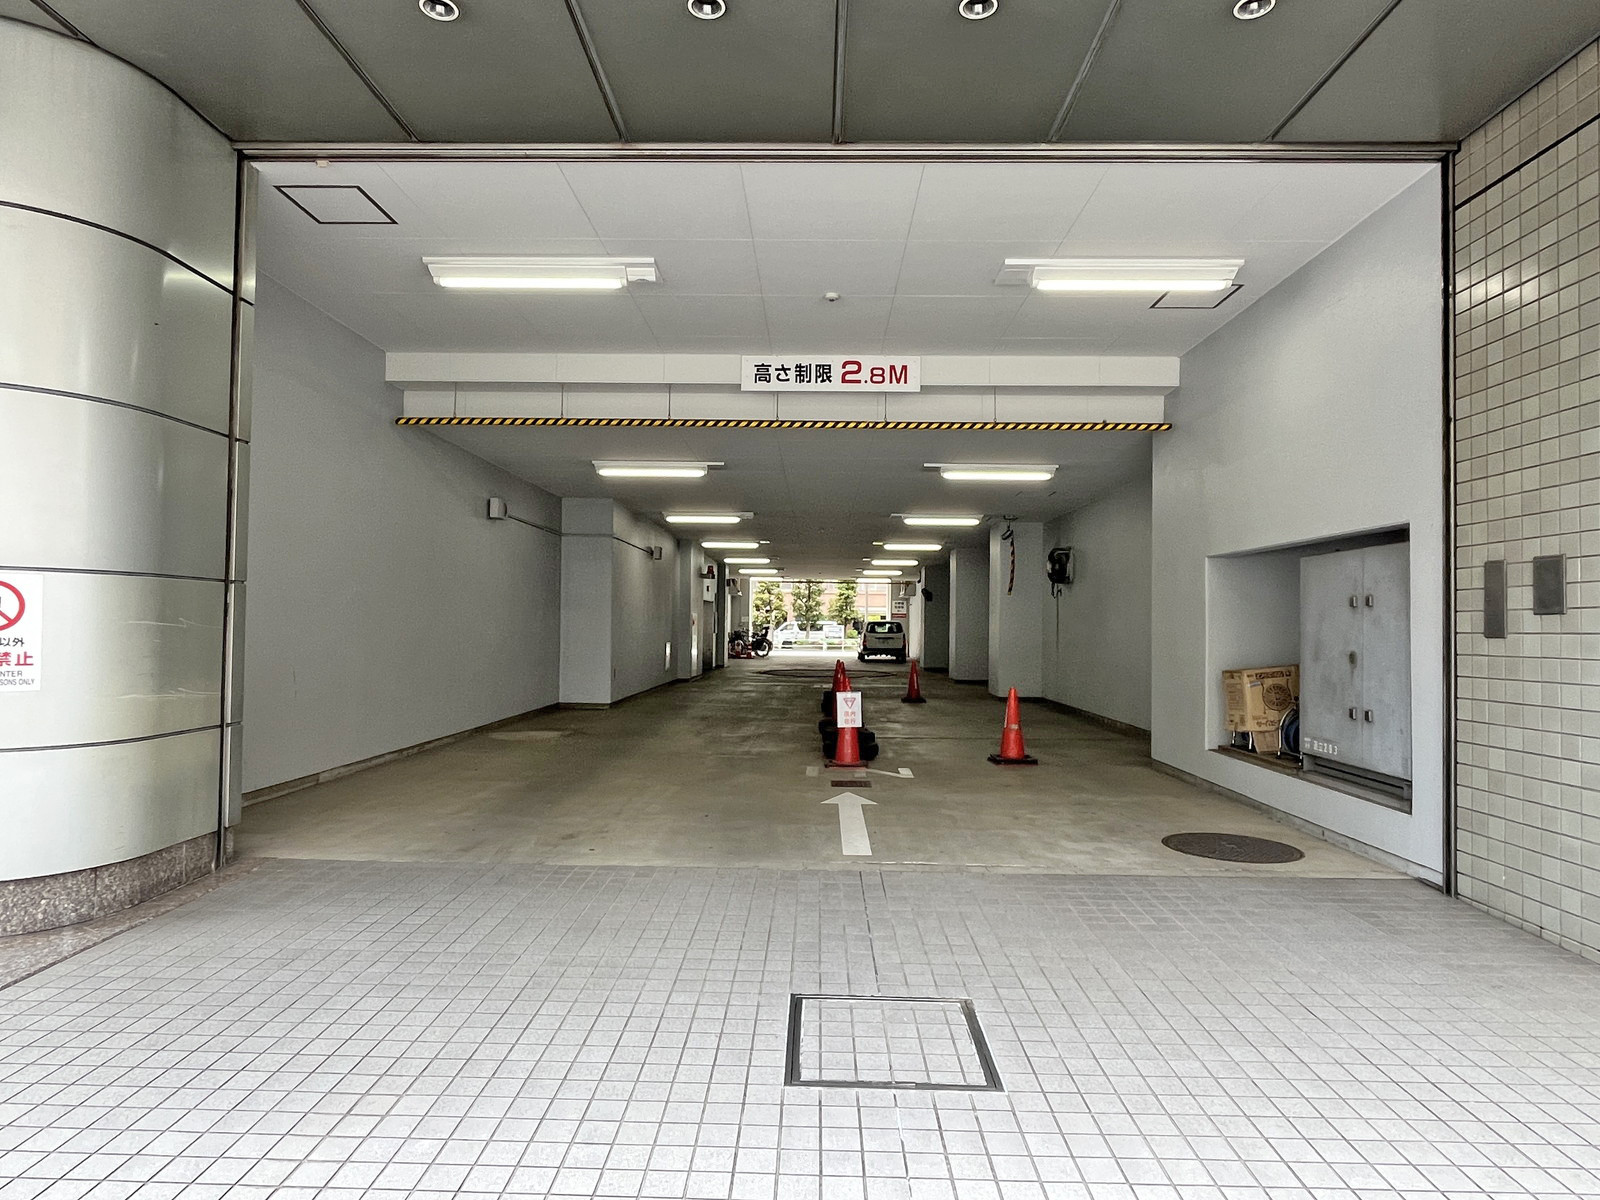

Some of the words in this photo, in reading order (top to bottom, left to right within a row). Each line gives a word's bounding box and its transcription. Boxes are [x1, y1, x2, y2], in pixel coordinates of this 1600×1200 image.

[754, 362, 832, 384] 高さ制限
[841, 360, 908, 385] 2.8M
[0, 637, 24, 647] 以外
